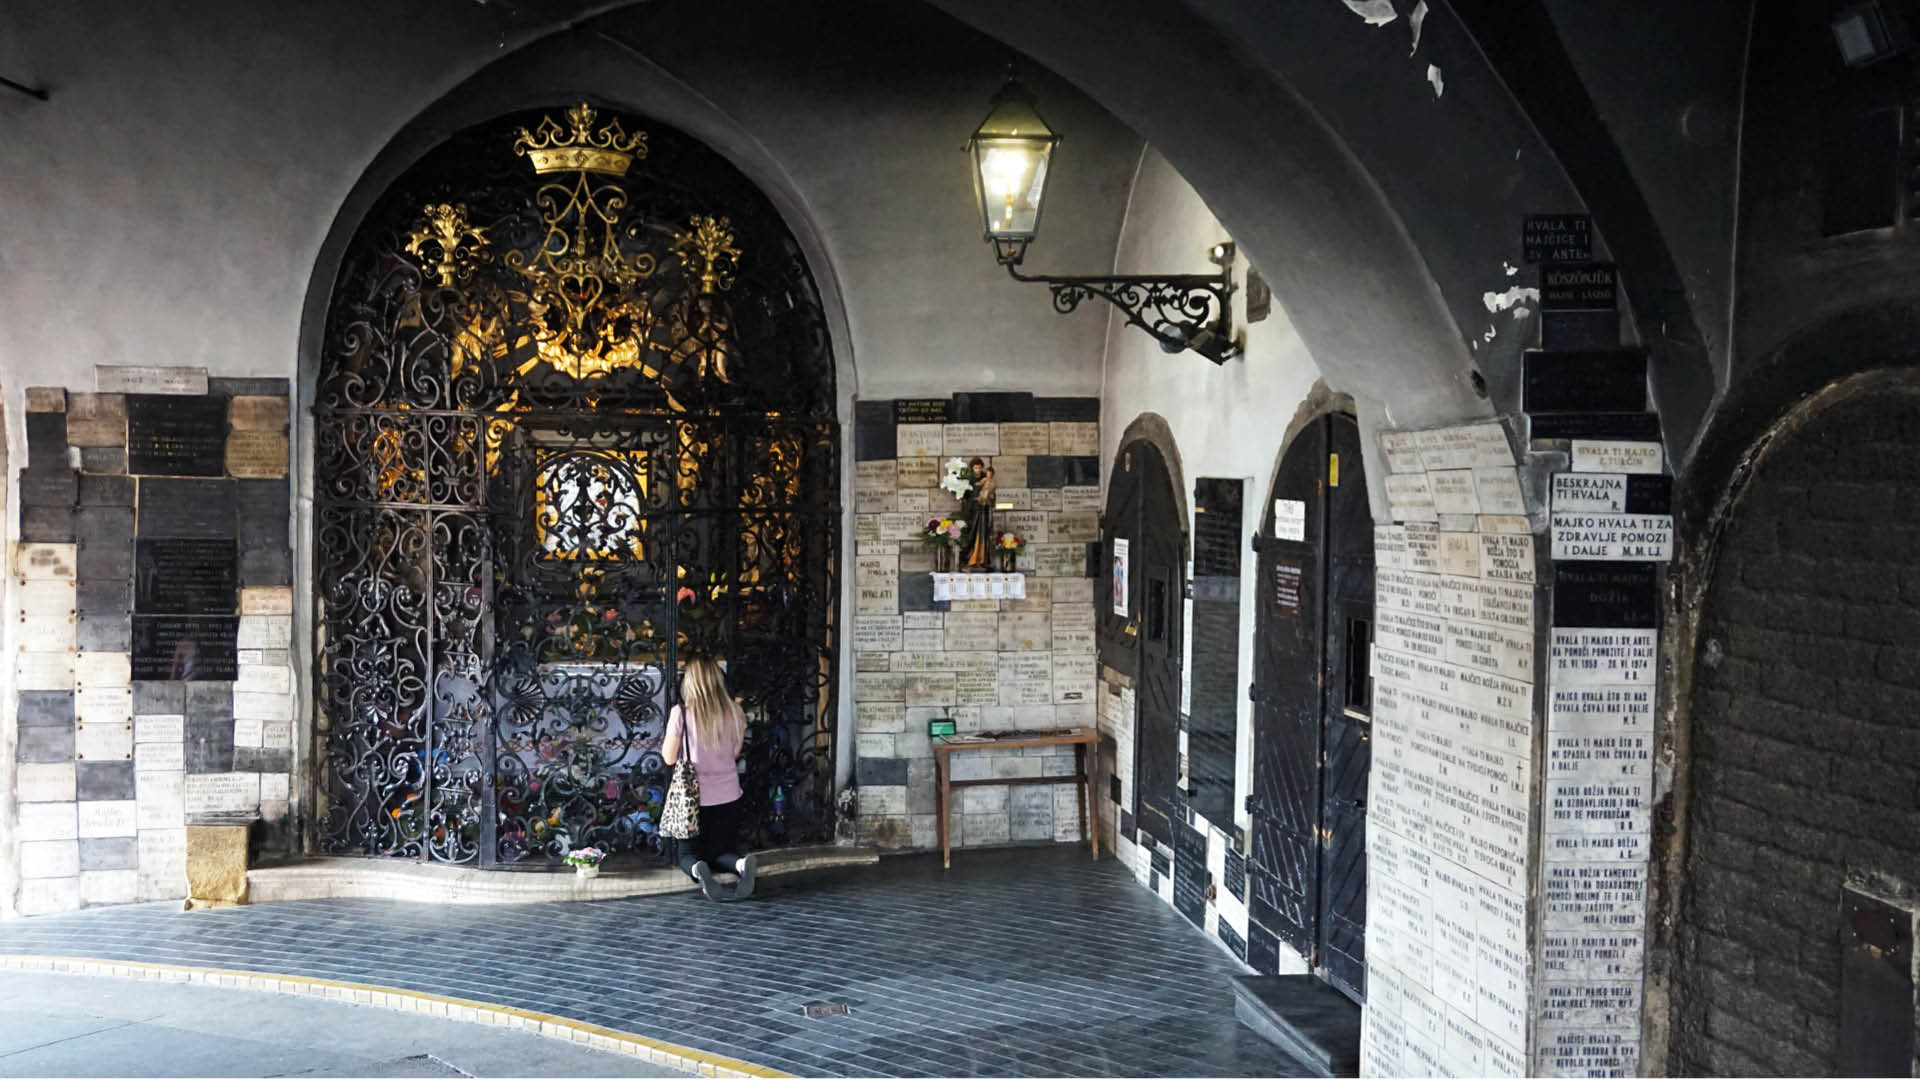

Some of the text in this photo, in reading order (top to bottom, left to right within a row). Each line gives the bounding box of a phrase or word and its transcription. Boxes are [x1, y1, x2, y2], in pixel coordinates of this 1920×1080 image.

[1556, 478, 1622, 490] BESKRAJNA
[1556, 489, 1610, 500] TI HVALA
[1554, 518, 1595, 528] MAJKO
[1598, 518, 1637, 529] HVALA
[1656, 520, 1672, 529] ZA
[1558, 532, 1666, 543] ZDRAVLJE POMOZI
[1572, 546, 1608, 556] DALJE
